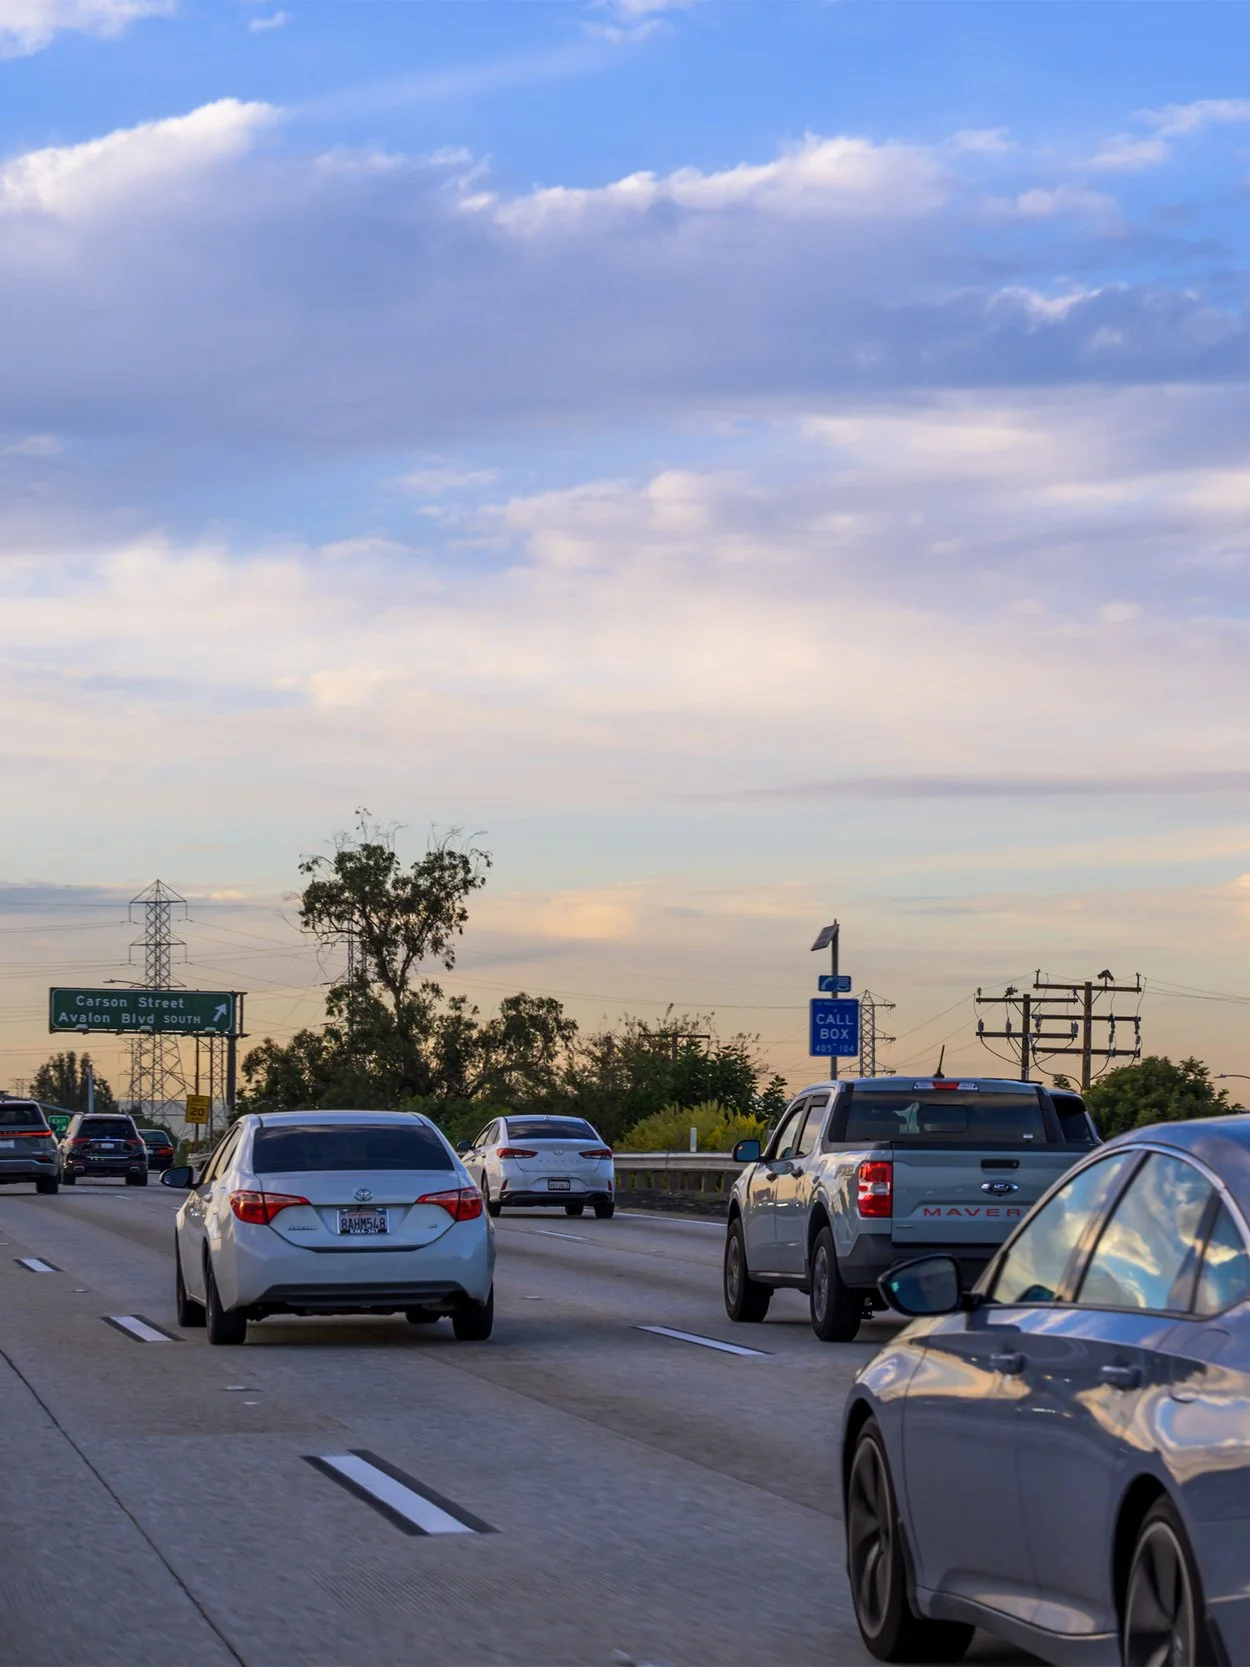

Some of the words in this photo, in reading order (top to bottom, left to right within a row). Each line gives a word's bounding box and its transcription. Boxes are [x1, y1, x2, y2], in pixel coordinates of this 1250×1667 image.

[75, 996, 128, 1008] Carson
[138, 997, 184, 1009] Street
[58, 1012, 111, 1024] Avalon
[121, 1013, 155, 1024] Blvd
[163, 1015, 201, 1024] SOUTH
[816, 1013, 854, 1025] CALL
[820, 1028, 849, 1040] BOX
[815, 1044, 832, 1052] 405
[189, 1107, 206, 1117] 20
[923, 1208, 1023, 1217] MAVER
[341, 1217, 386, 1230] 8AHM548
